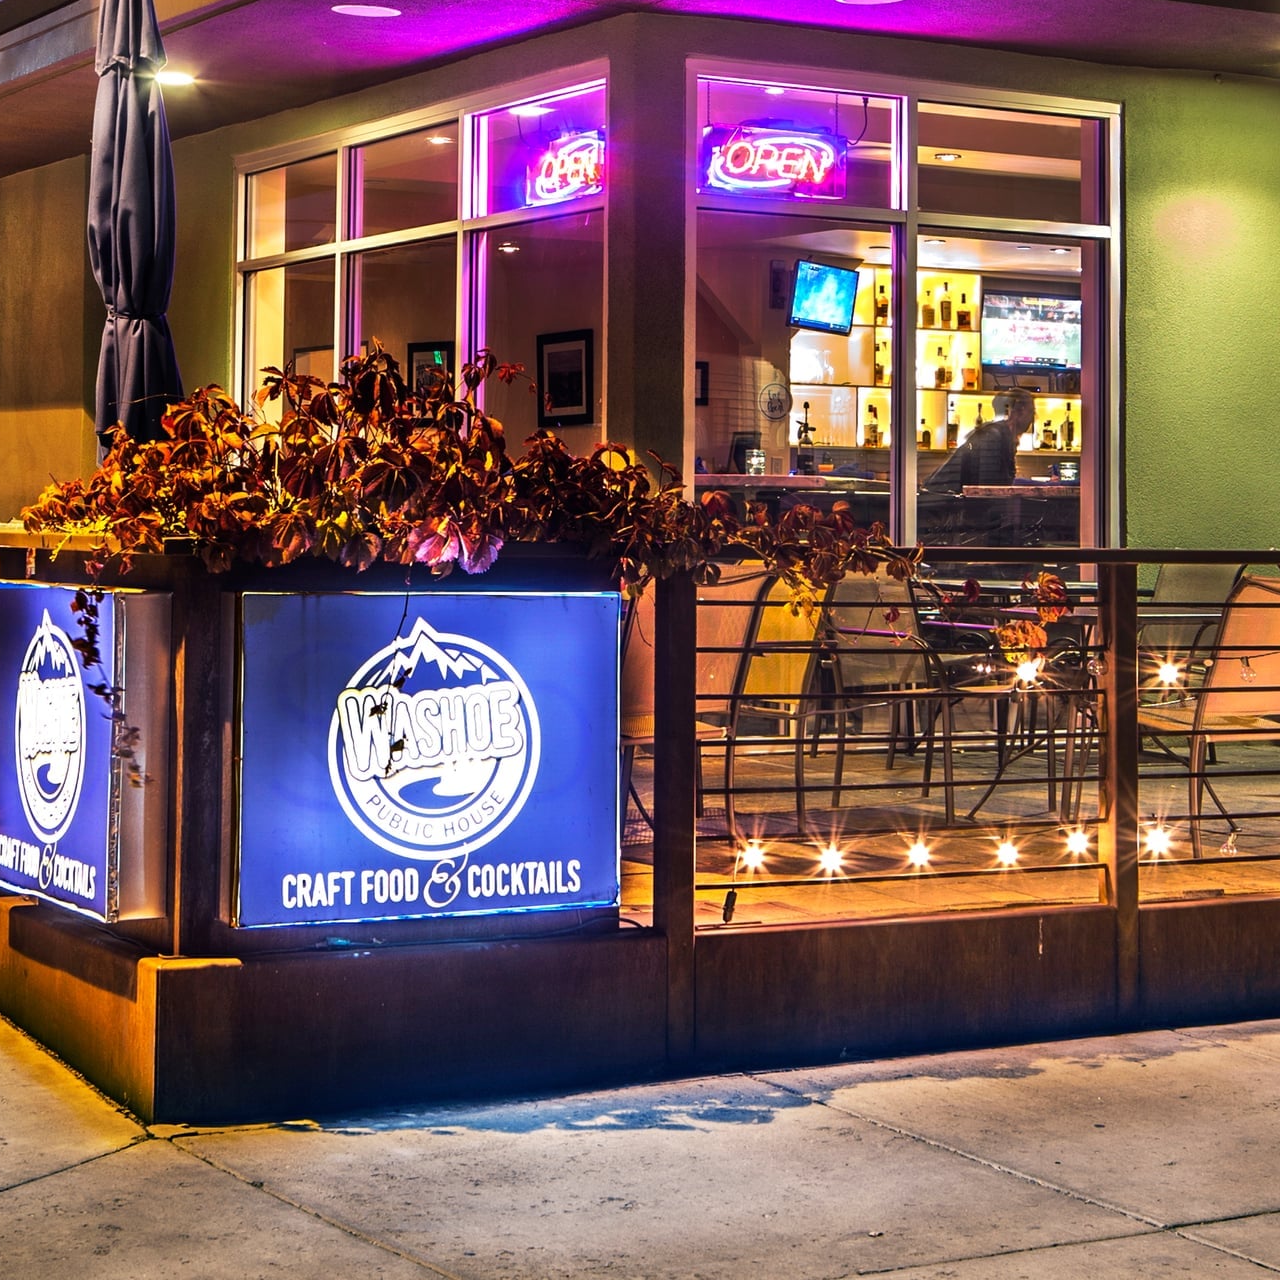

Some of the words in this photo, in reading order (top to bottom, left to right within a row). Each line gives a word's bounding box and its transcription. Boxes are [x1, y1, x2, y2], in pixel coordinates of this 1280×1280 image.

[540, 151, 601, 184] OPEN
[727, 141, 834, 184] OPEN
[345, 687, 515, 773] WASHOE
[366, 793, 433, 840] PUBLIC
[443, 789, 505, 839] HOUSE
[19, 841, 41, 879] FOOD
[52, 854, 97, 900] COCKTAILS
[282, 871, 355, 909] CRAFT
[360, 868, 419, 905] FOOD
[423, 842, 471, 909] &
[467, 859, 581, 898] COCKTAILS
